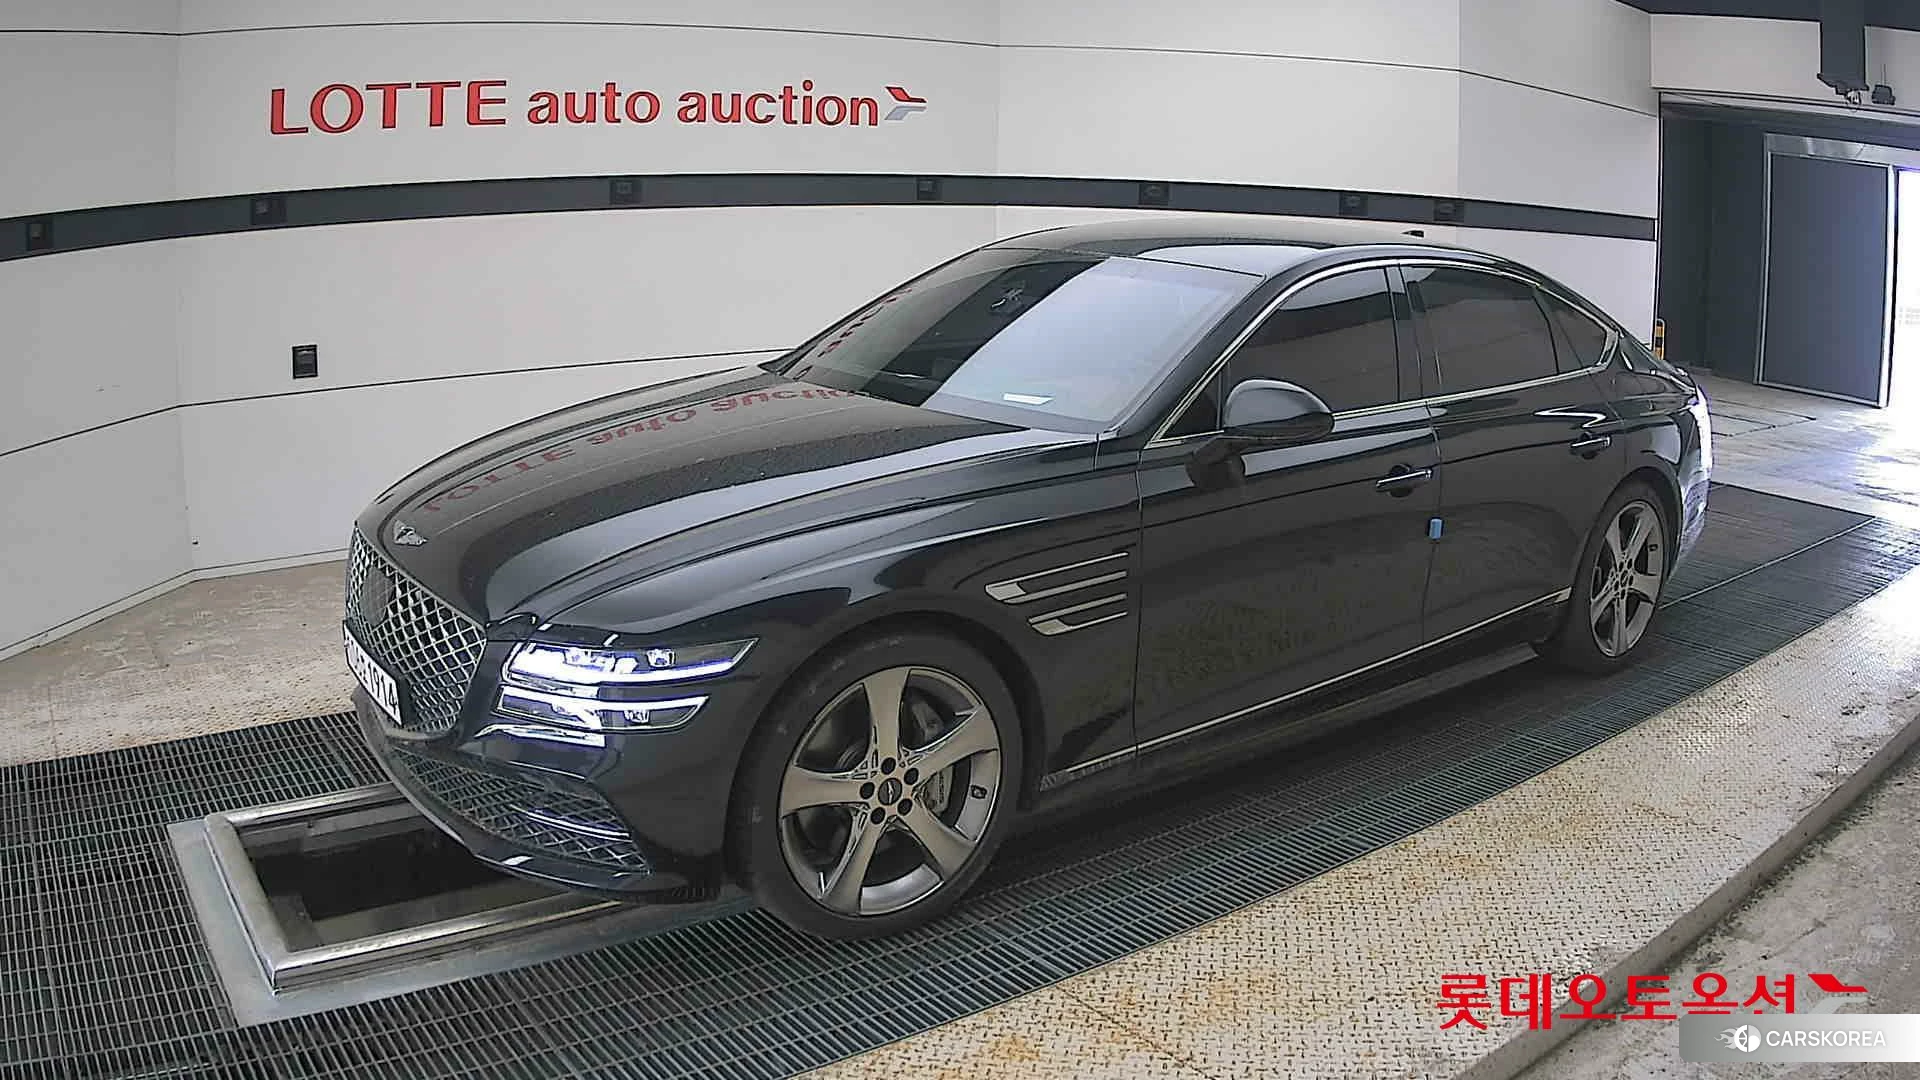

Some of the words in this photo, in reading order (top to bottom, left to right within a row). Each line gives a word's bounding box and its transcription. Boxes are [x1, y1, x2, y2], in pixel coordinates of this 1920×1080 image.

[270, 79, 507, 134] LOTTE
[527, 82, 660, 125] auto
[677, 80, 878, 126] auction
